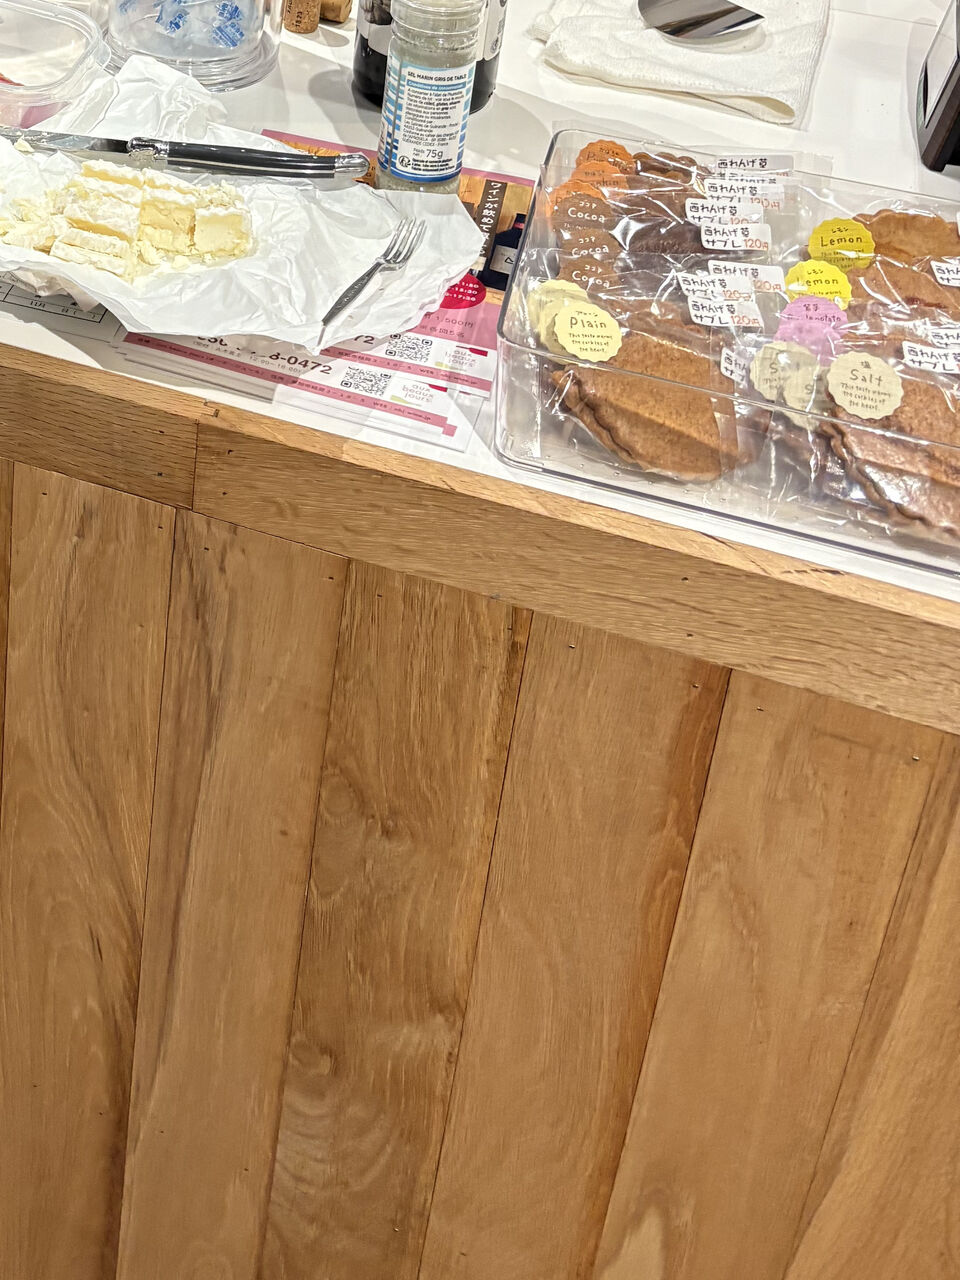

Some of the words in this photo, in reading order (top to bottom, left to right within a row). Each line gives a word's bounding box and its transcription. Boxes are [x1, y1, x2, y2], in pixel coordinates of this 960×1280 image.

[426, 148, 444, 159] 75g
[567, 207, 606, 223] Cocoa
[704, 238, 742, 248] サブレ
[743, 238, 769, 250] 120円
[820, 235, 863, 248] Lemon
[571, 243, 609, 257] Cocoa
[569, 316, 607, 329] Plain
[693, 314, 730, 325] サブレ
[730, 314, 761, 327] 120円
[910, 358, 955, 371] サブレ
[849, 369, 884, 386] Salt
[401, 384, 434, 399] beaux
[411, 384, 431, 392] aux
[404, 393, 433, 403] jours
